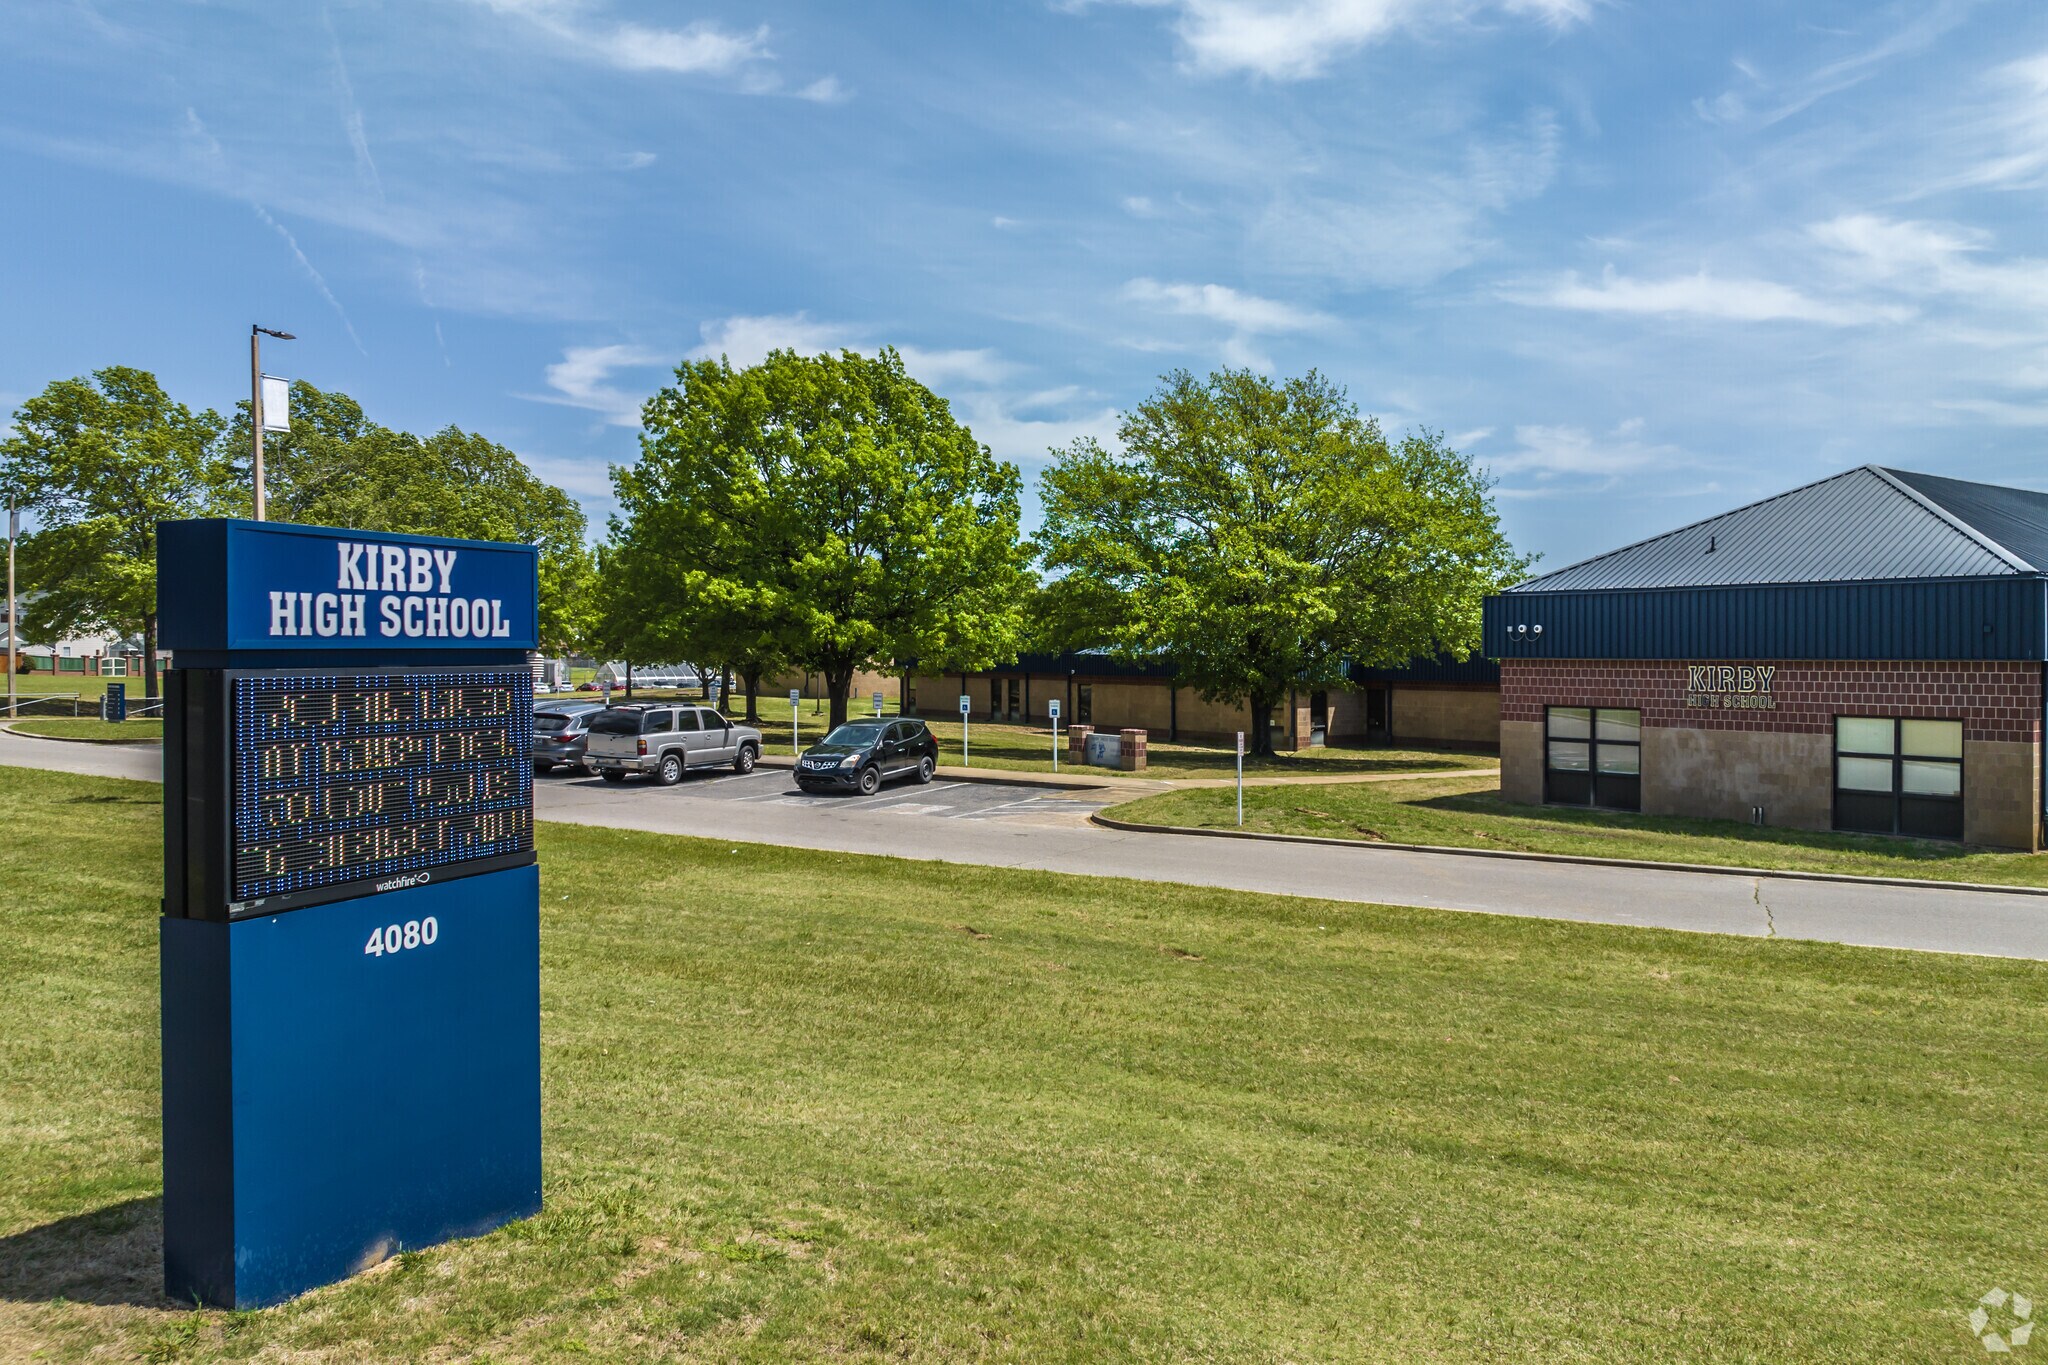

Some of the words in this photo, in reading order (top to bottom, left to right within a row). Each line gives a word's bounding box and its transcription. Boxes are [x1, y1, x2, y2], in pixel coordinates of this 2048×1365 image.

[337, 542, 457, 594] KIRBY
[269, 591, 366, 637] HIGH
[380, 595, 510, 638] SCHOOL
[1688, 666, 1775, 693] KIRBY
[1688, 694, 1720, 708] HIGH
[1724, 695, 1776, 709] SCHOOL
[376, 875, 416, 892] watchfire
[364, 916, 439, 957] 4080
